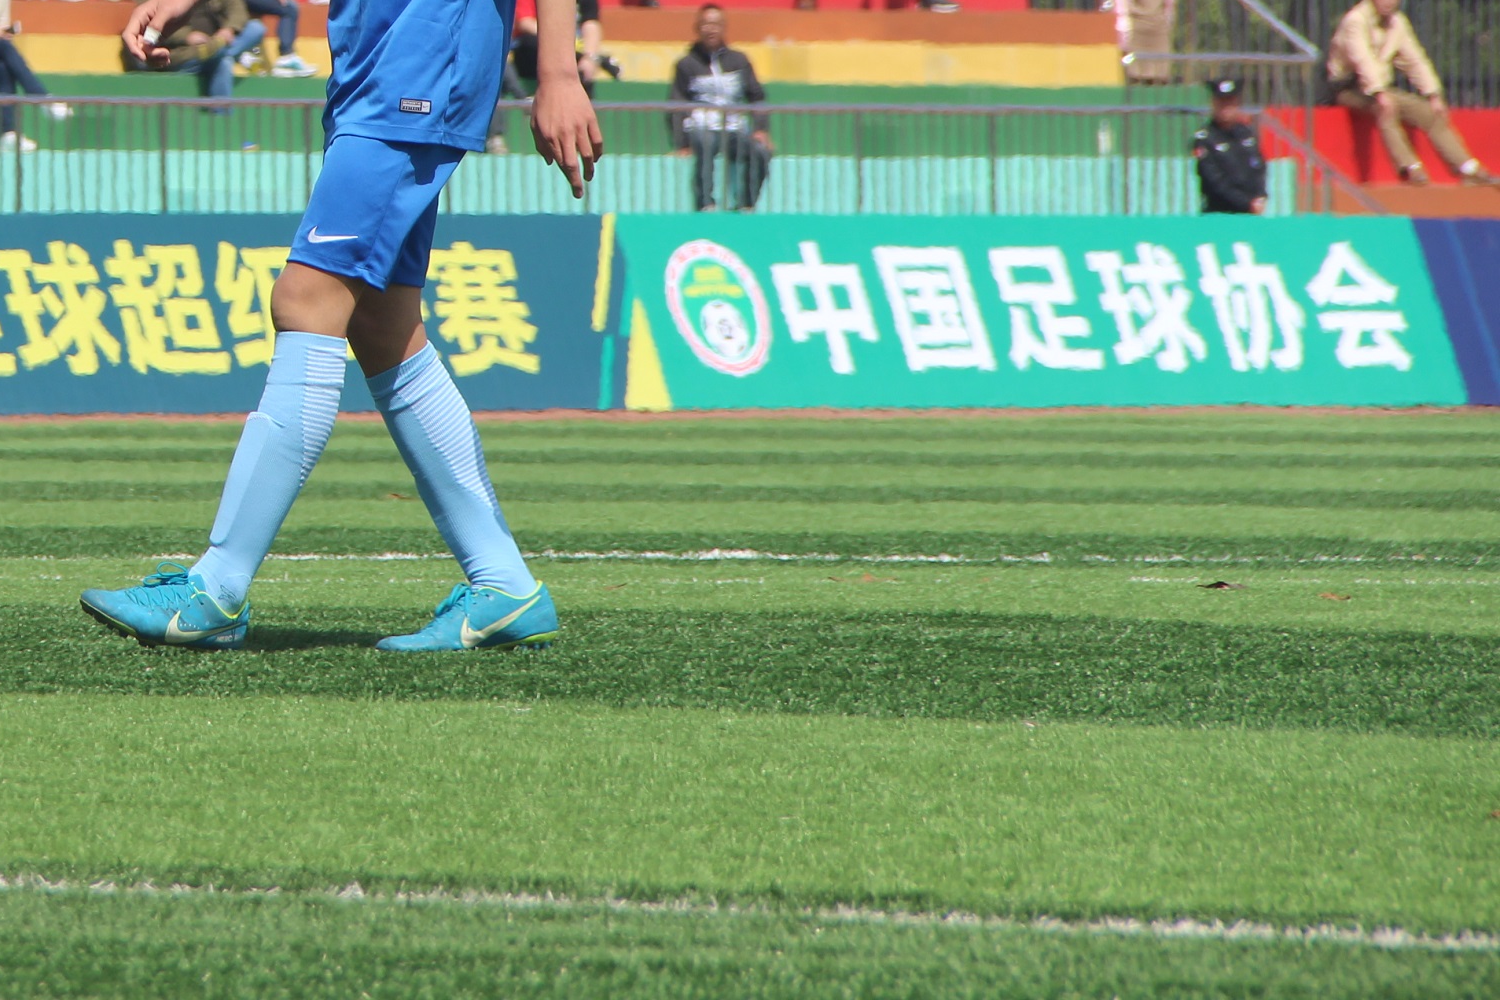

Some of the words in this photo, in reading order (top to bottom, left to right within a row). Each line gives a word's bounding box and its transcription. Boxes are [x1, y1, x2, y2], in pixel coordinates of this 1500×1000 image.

[771, 239, 1413, 375] 中国足球协会
